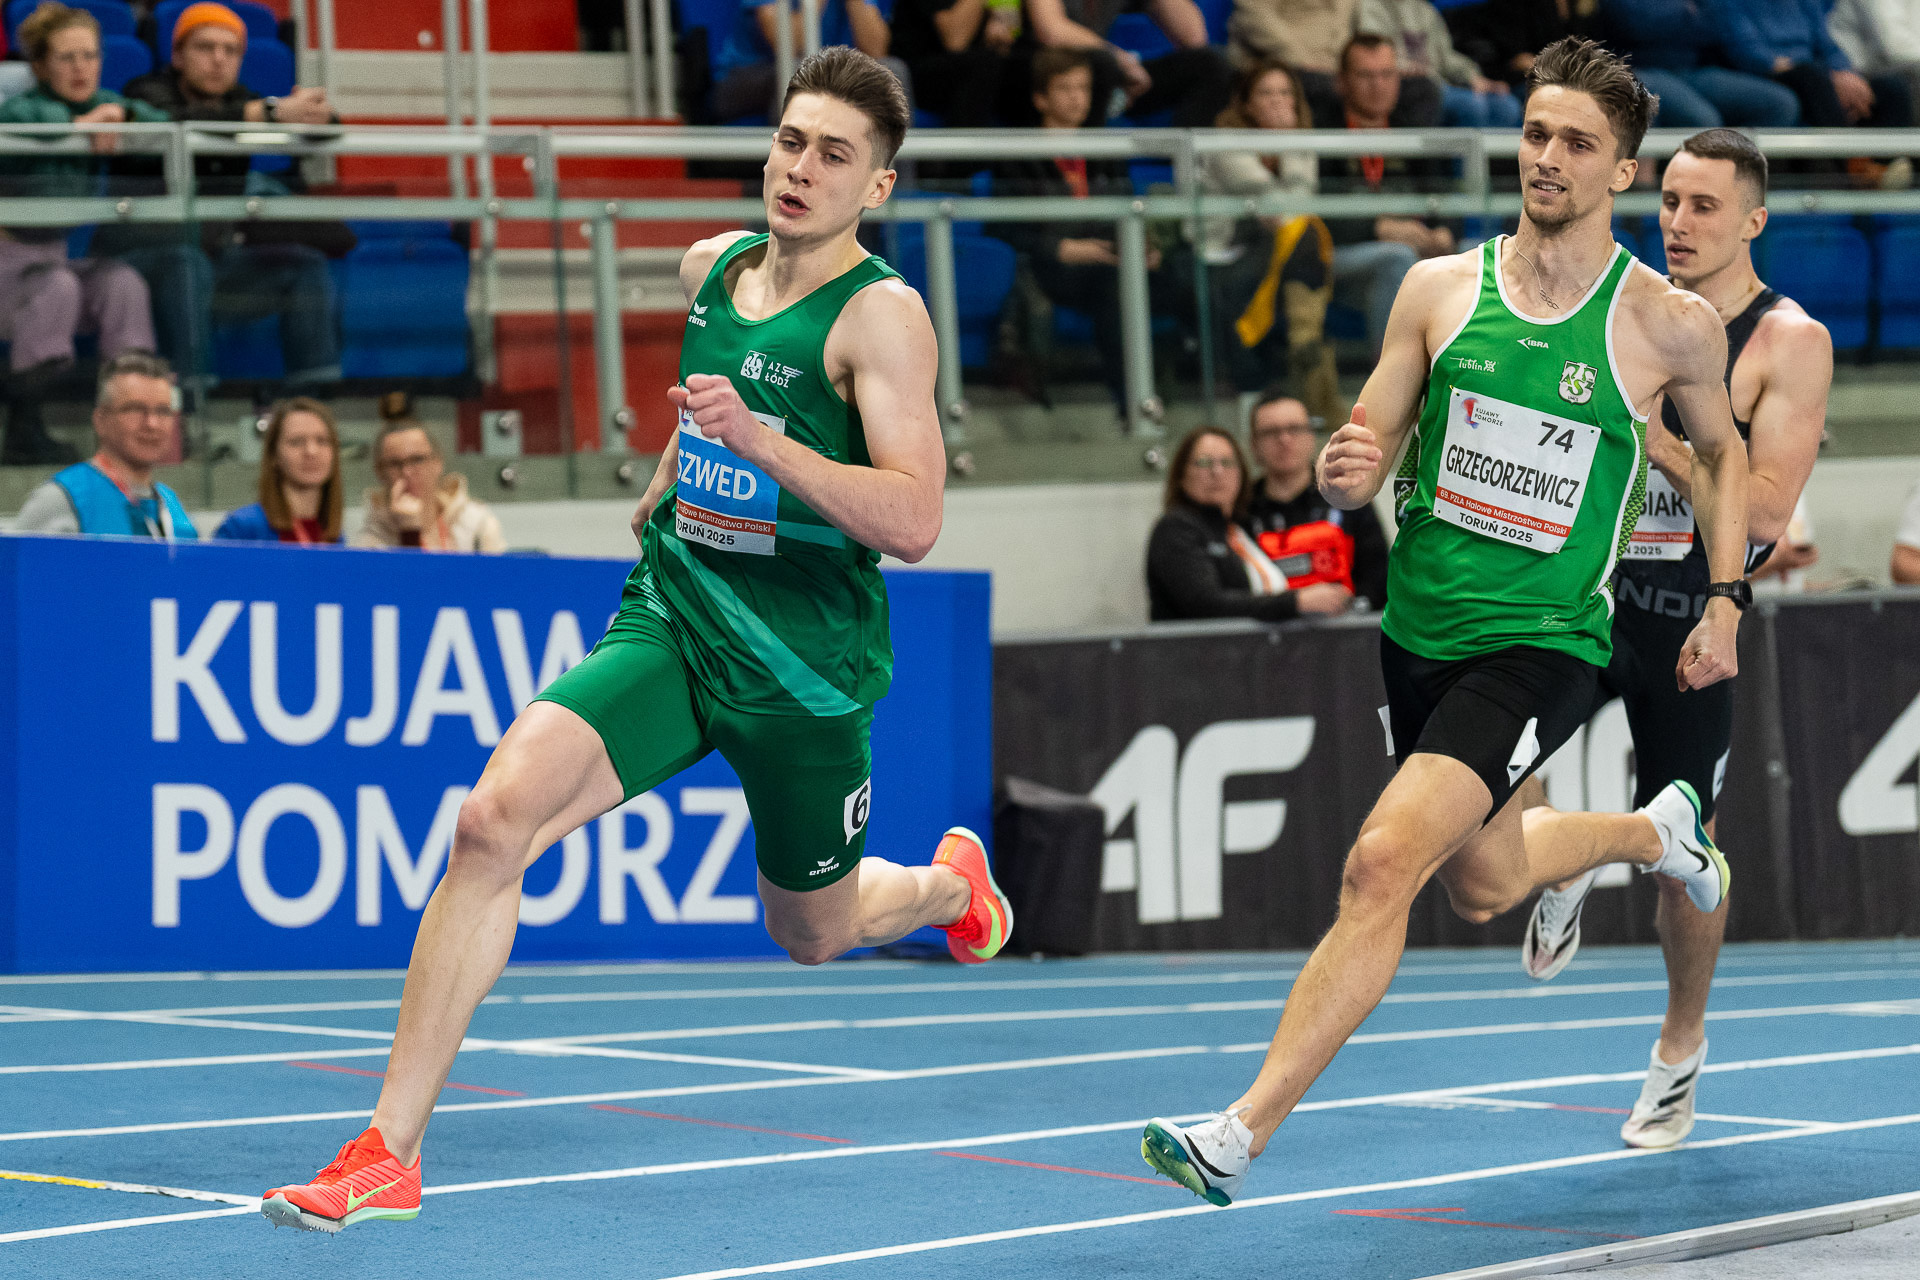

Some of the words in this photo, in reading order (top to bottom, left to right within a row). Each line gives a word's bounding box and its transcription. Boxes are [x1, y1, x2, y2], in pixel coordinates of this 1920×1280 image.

[764, 372, 790, 388] ŁÓDŹ
[1474, 413, 1504, 427] POMORZE
[1475, 407, 1500, 419] KUJAWY
[1537, 421, 1575, 454] 74
[678, 448, 757, 501] SZWED
[1446, 444, 1580, 509] GRZEGORZEWICZ
[698, 511, 742, 529] Mistrzostwa
[744, 522, 771, 533] Polski
[1449, 494, 1465, 505] PZLA
[1466, 499, 1493, 514] Halowe
[1493, 509, 1542, 529] Mistrzostwa
[1544, 522, 1567, 535] Polski
[1458, 512, 1499, 534] TORUŃ
[1500, 525, 1534, 543] 2025
[707, 529, 735, 546] 2025
[1634, 546, 1662, 555] 2025
[151, 597, 620, 746] KUJAW
[852, 784, 868, 830] 6
[1089, 715, 1316, 925] 4F
[151, 782, 759, 928] POMORZ
[808, 862, 840, 876] erima
